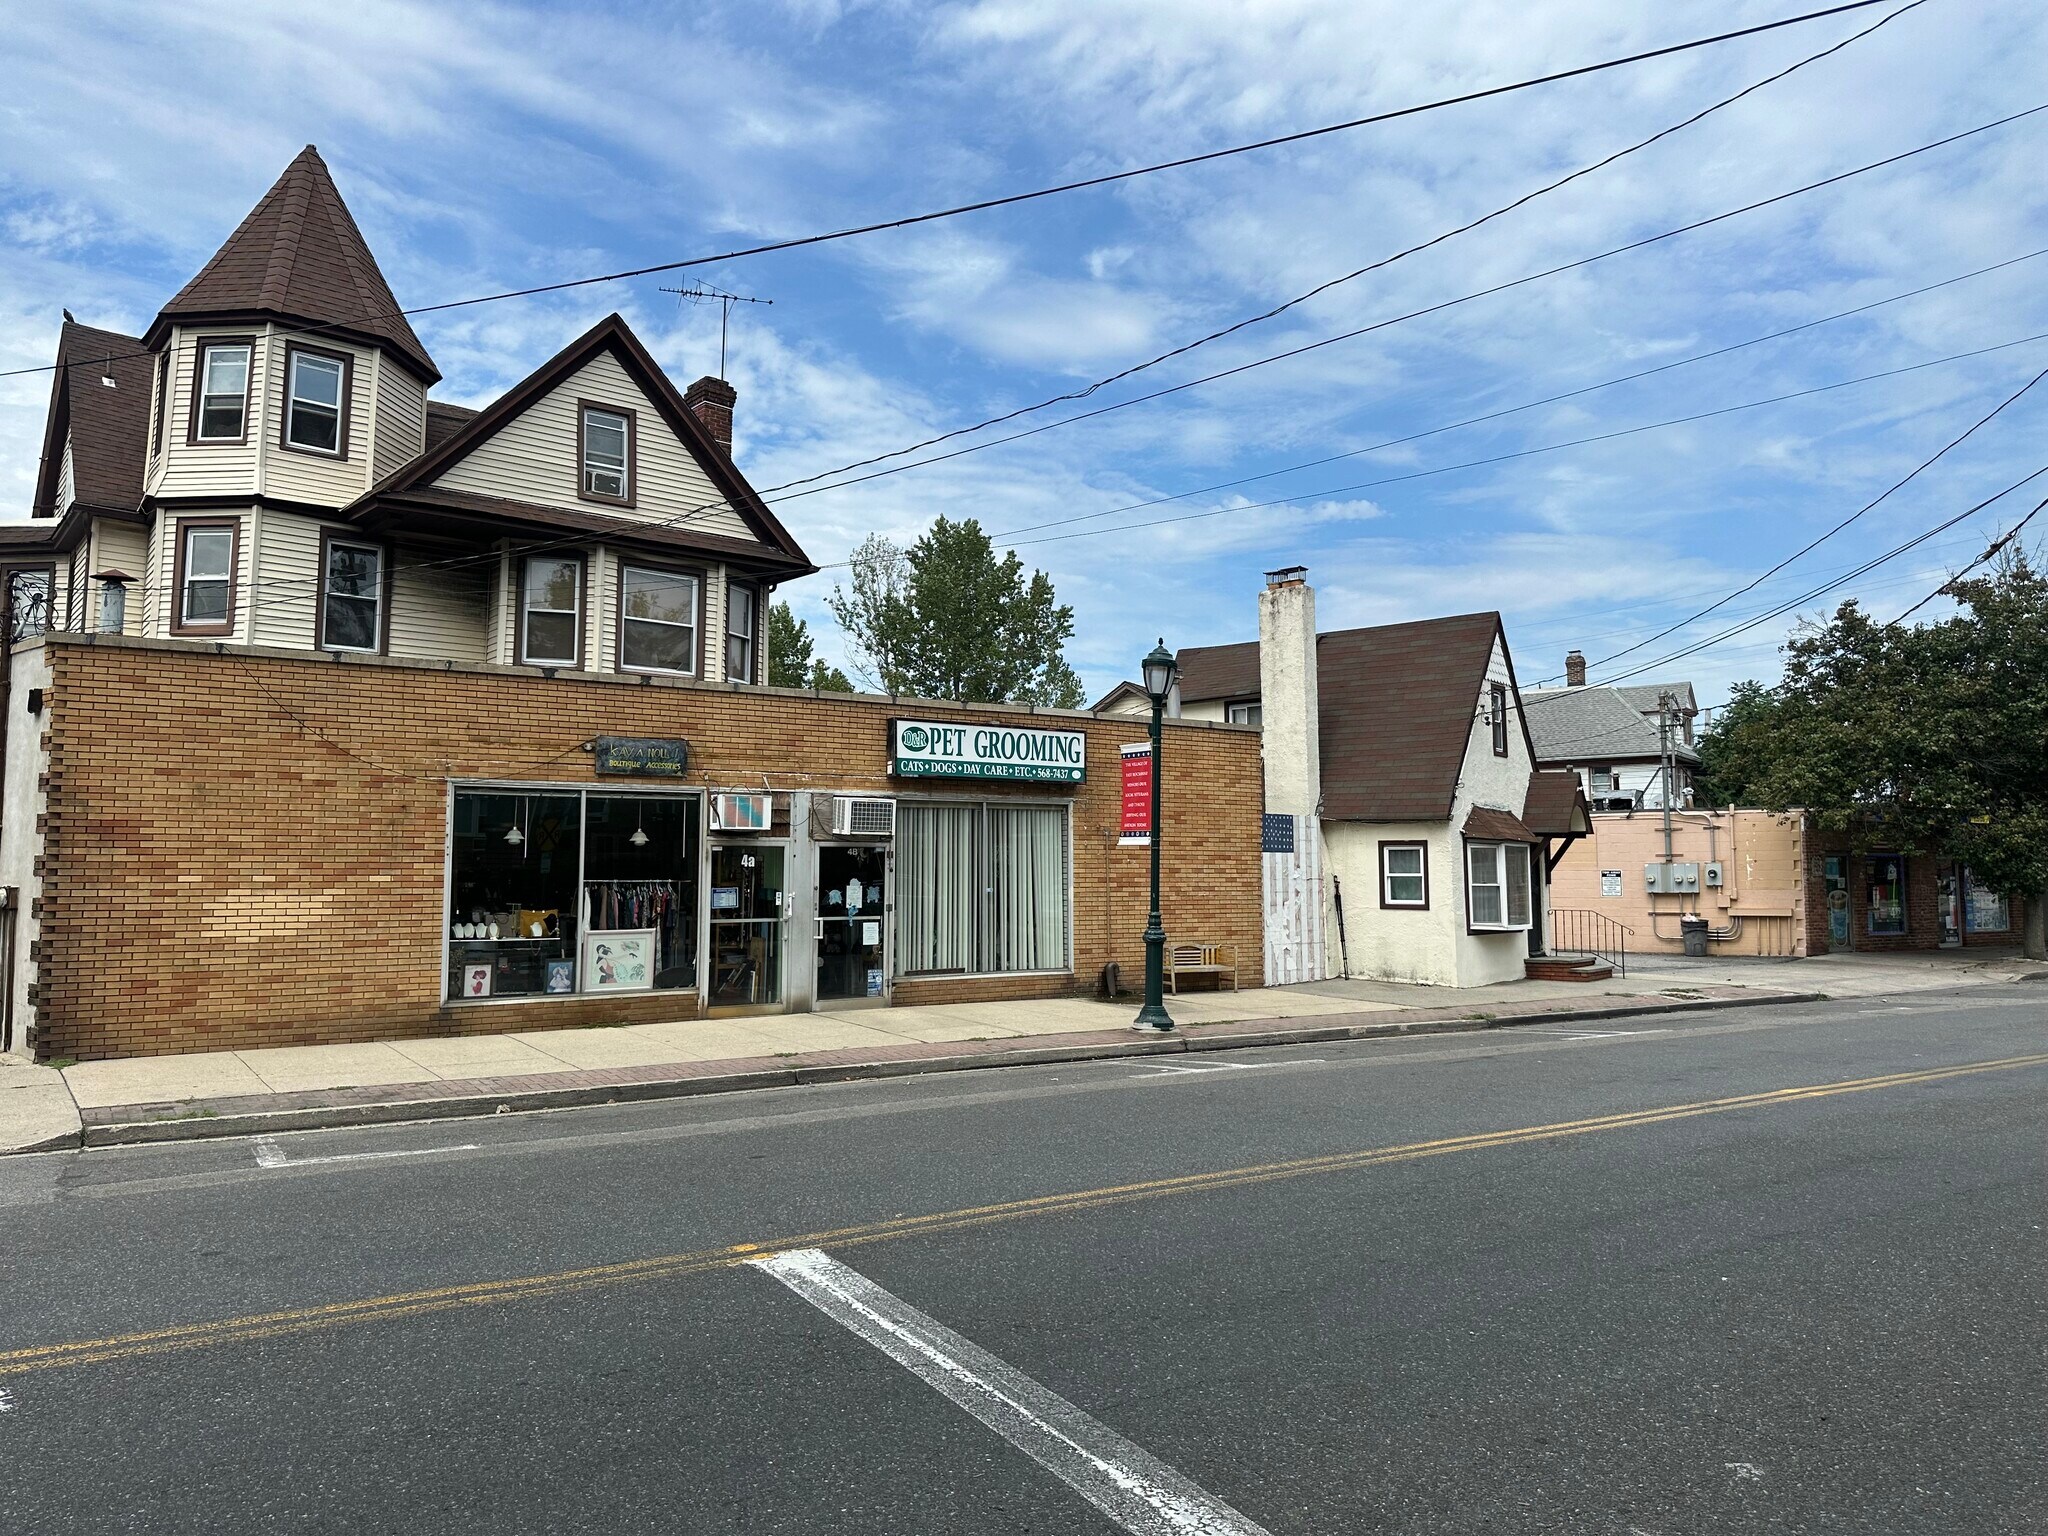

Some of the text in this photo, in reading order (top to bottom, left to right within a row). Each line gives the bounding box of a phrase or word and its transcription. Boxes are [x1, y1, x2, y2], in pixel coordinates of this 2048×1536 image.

[903, 727, 1081, 763] D&R PET GROOMING
[900, 760, 924, 772] CATS
[931, 762, 957, 774] DOGS
[963, 763, 981, 775] DAY
[984, 764, 1008, 776] CARE
[1014, 766, 1032, 778] ETC.
[1037, 767, 1069, 779] 568-7437
[847, 848, 858, 856] 4B
[741, 854, 756, 868] 4a
